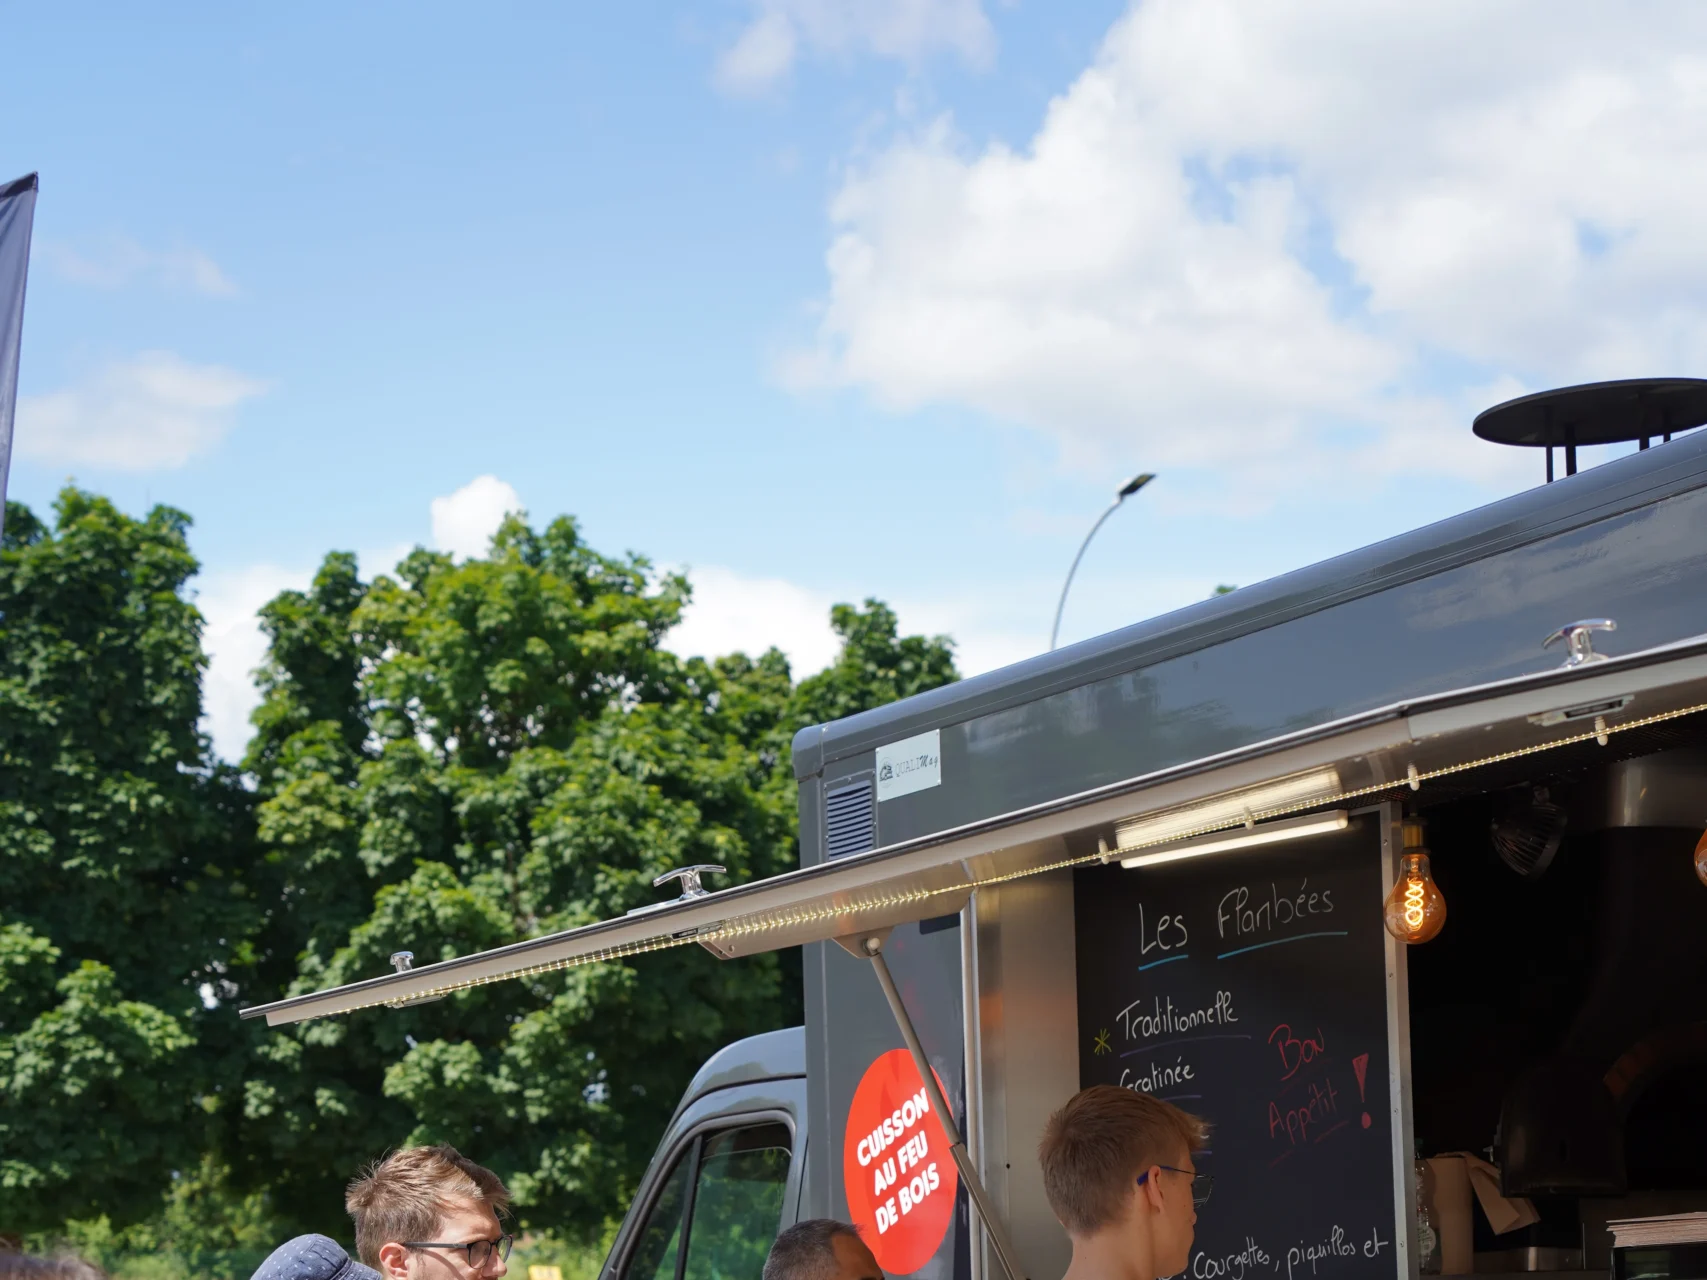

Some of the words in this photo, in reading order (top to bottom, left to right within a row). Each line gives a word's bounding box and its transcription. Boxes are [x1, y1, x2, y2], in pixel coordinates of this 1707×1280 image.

[1139, 903, 1188, 955] Les
[1116, 990, 1239, 1041] Traditionnelle
[857, 1087, 930, 1167] CUISSON
[874, 1157, 897, 1196] AU
[897, 1130, 928, 1174] FEU
[875, 1197, 899, 1235] DE
[898, 1162, 940, 1215] BOIS
[1287, 1225, 1356, 1280] piquillos
[1363, 1226, 1389, 1258] et
